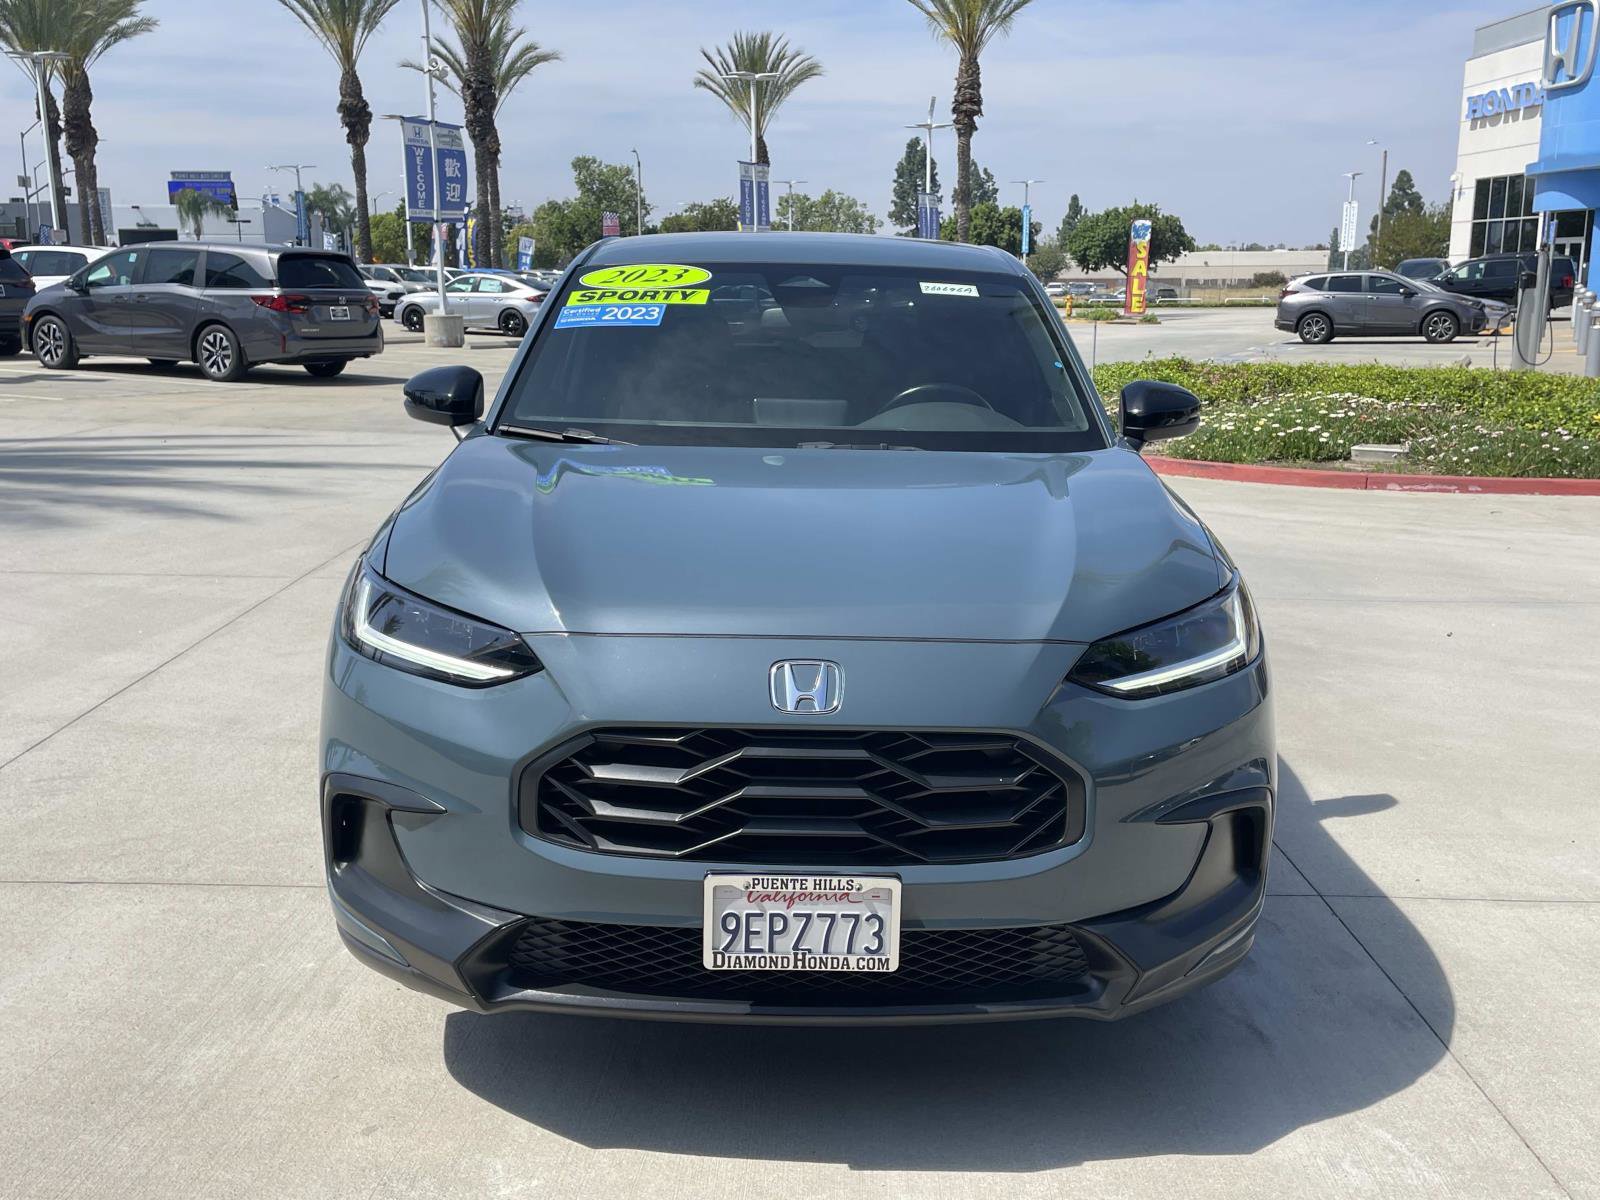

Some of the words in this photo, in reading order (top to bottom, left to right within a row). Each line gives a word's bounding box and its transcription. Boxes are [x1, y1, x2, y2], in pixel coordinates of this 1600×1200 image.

[412, 146, 426, 208] WELCOME
[445, 158, 461, 202] 歡迎
[599, 268, 689, 284] 2023
[1131, 242, 1147, 312] SALE
[576, 290, 698, 303] SPORTY
[601, 306, 660, 320] 2023
[751, 878, 808, 891] PUENTE
[813, 879, 855, 892] HILLS
[747, 891, 863, 909] California
[720, 911, 885, 954] 9EPZ773
[712, 951, 890, 970] DIAMONDHONDA.COM
